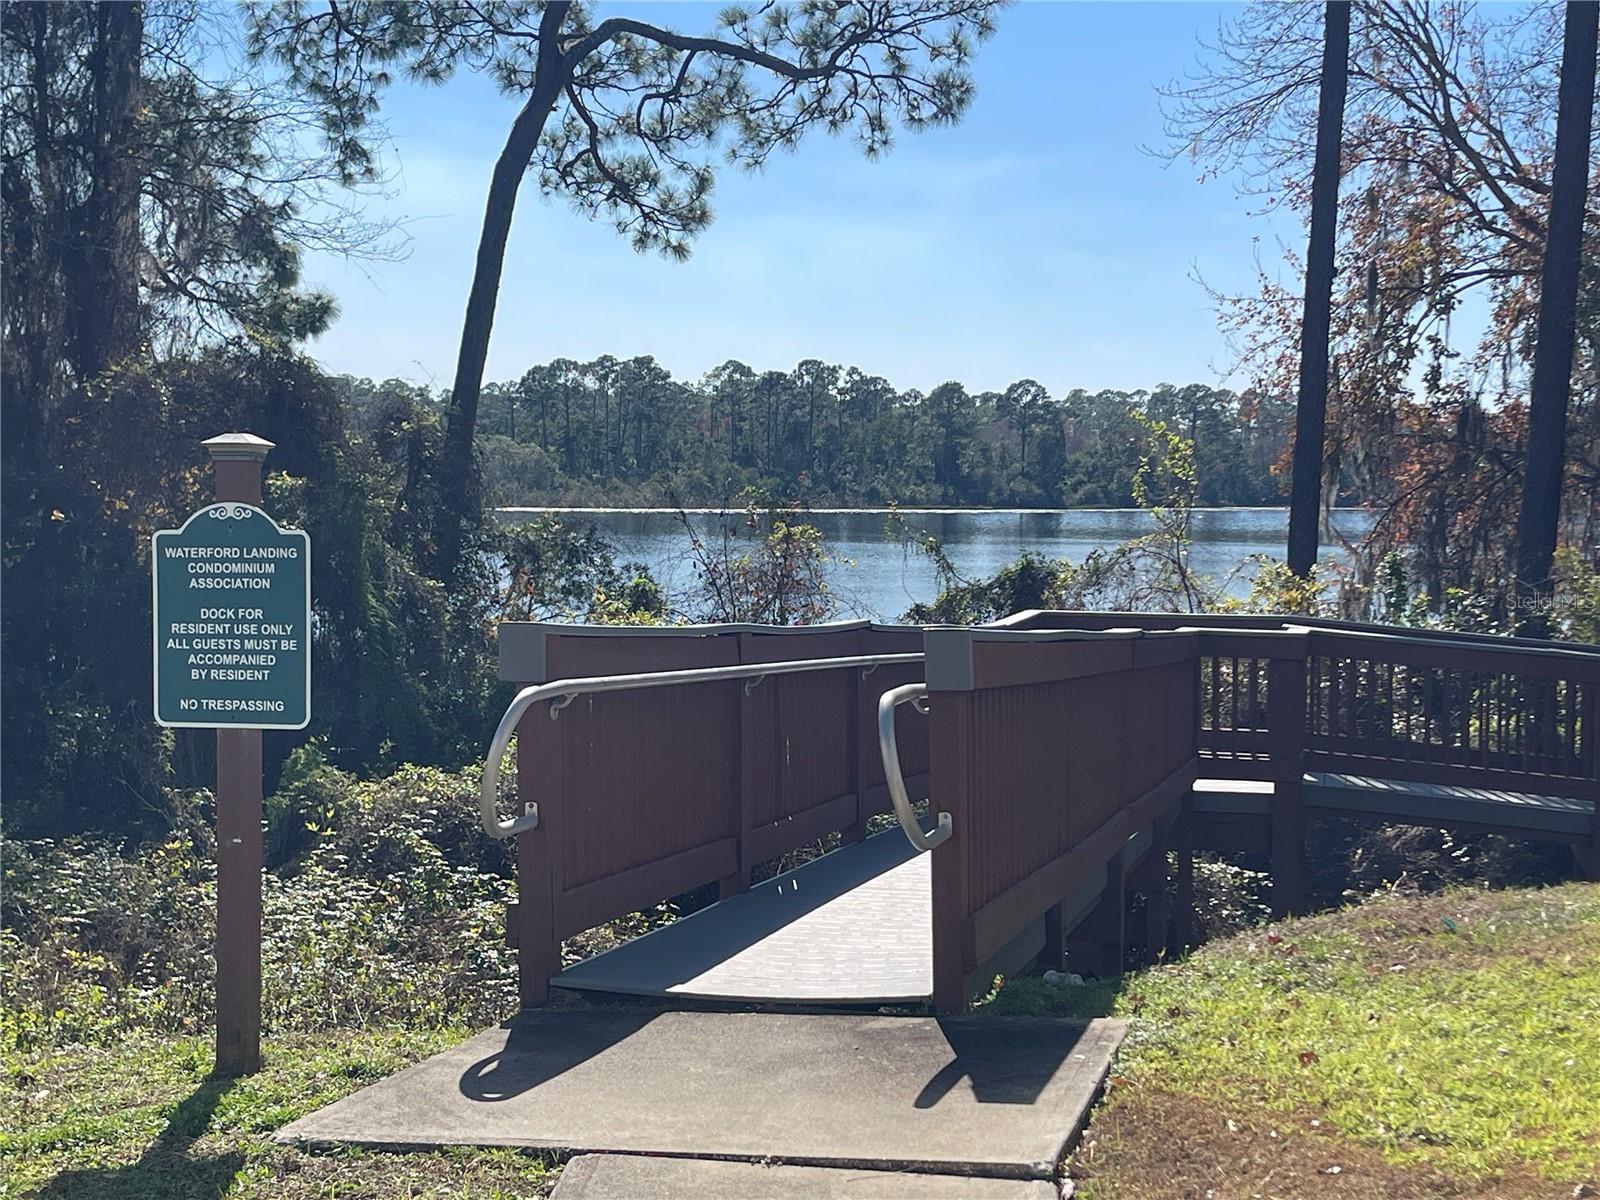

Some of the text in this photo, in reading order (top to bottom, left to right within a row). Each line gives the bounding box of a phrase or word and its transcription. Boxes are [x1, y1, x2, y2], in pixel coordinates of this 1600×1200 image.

[164, 547, 298, 559] WATERFORD LANDING
[187, 562, 275, 574] CONDOMINIUM
[189, 577, 271, 589] ASSOCIATION
[200, 608, 264, 620] DOCK FOR
[171, 623, 295, 635] RESIDENT USE ONLY
[166, 638, 298, 651] ALL GUESTS MUST BE
[187, 653, 277, 666] ACCOMPANIED
[191, 668, 271, 681] BY RESIDENT
[179, 698, 285, 712] NO TRESPASSING
